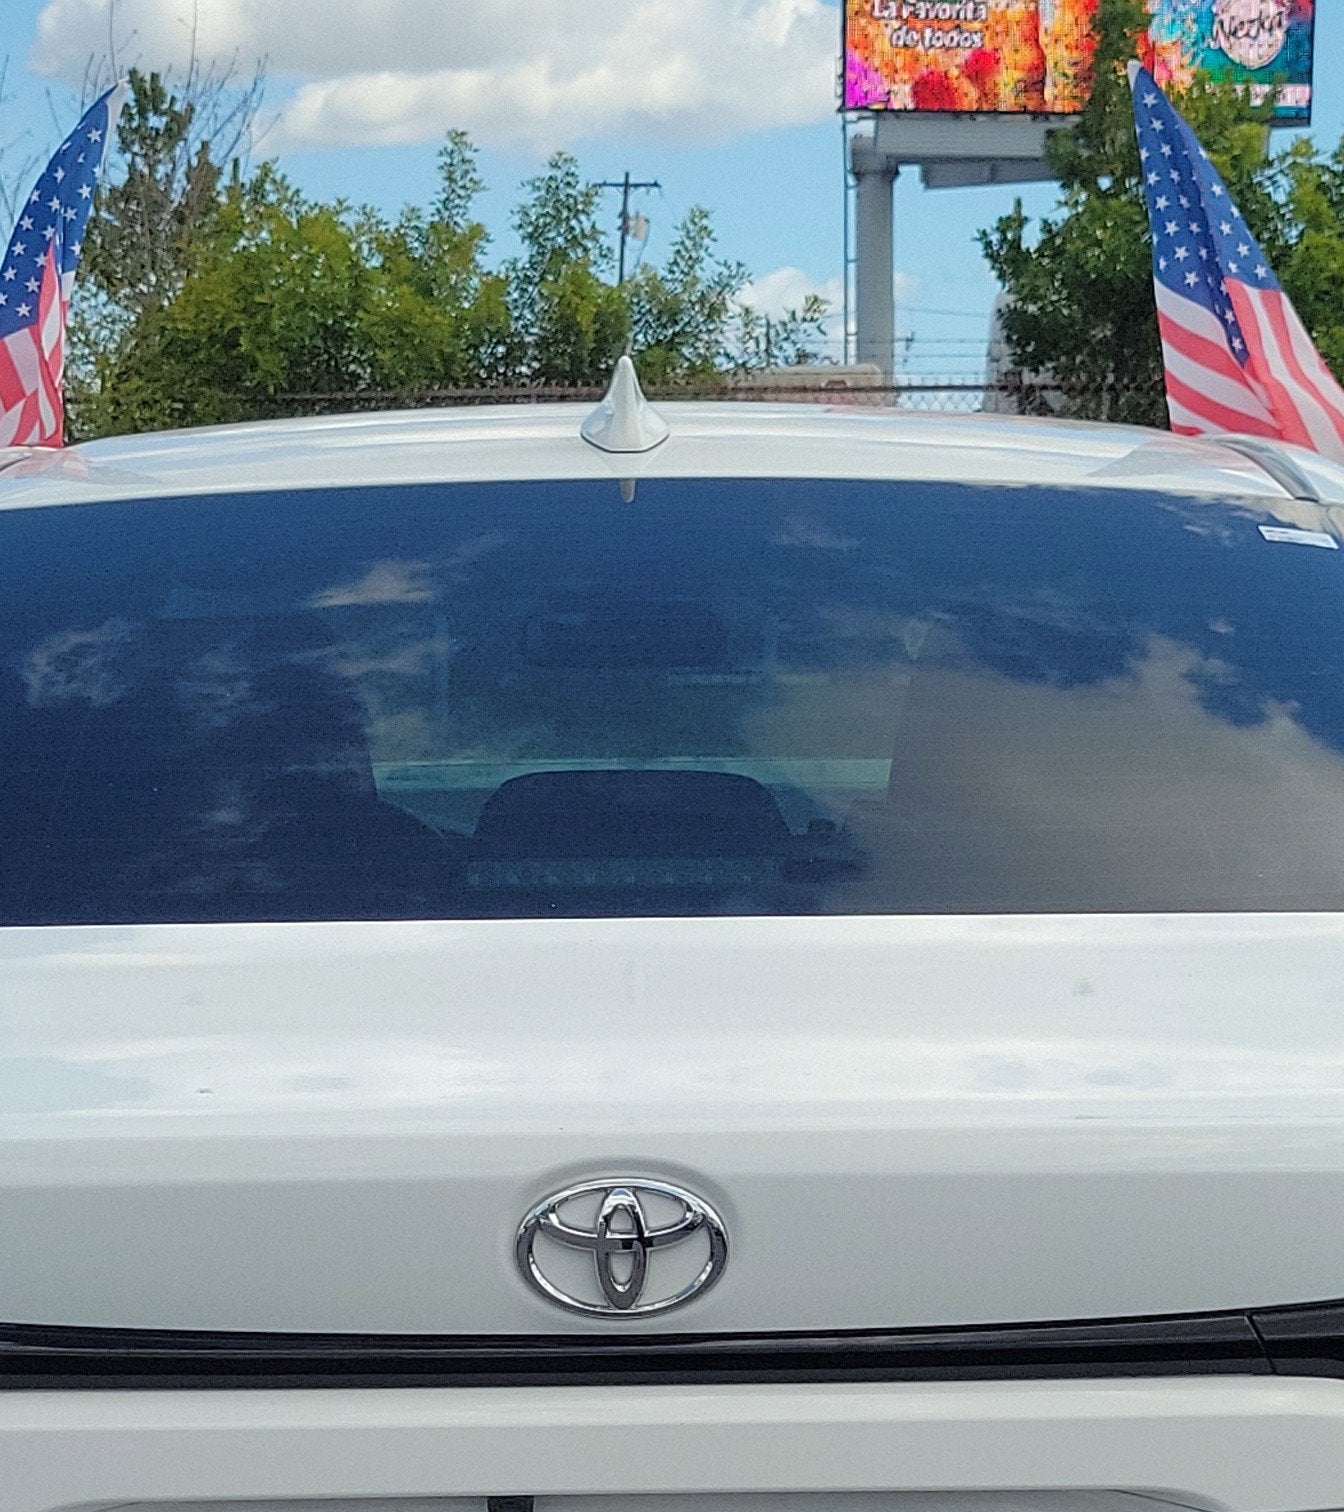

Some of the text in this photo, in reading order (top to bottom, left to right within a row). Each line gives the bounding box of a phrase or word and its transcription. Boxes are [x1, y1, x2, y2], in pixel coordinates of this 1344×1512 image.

[872, 0, 897, 19] La
[891, 24, 984, 49] de todos
